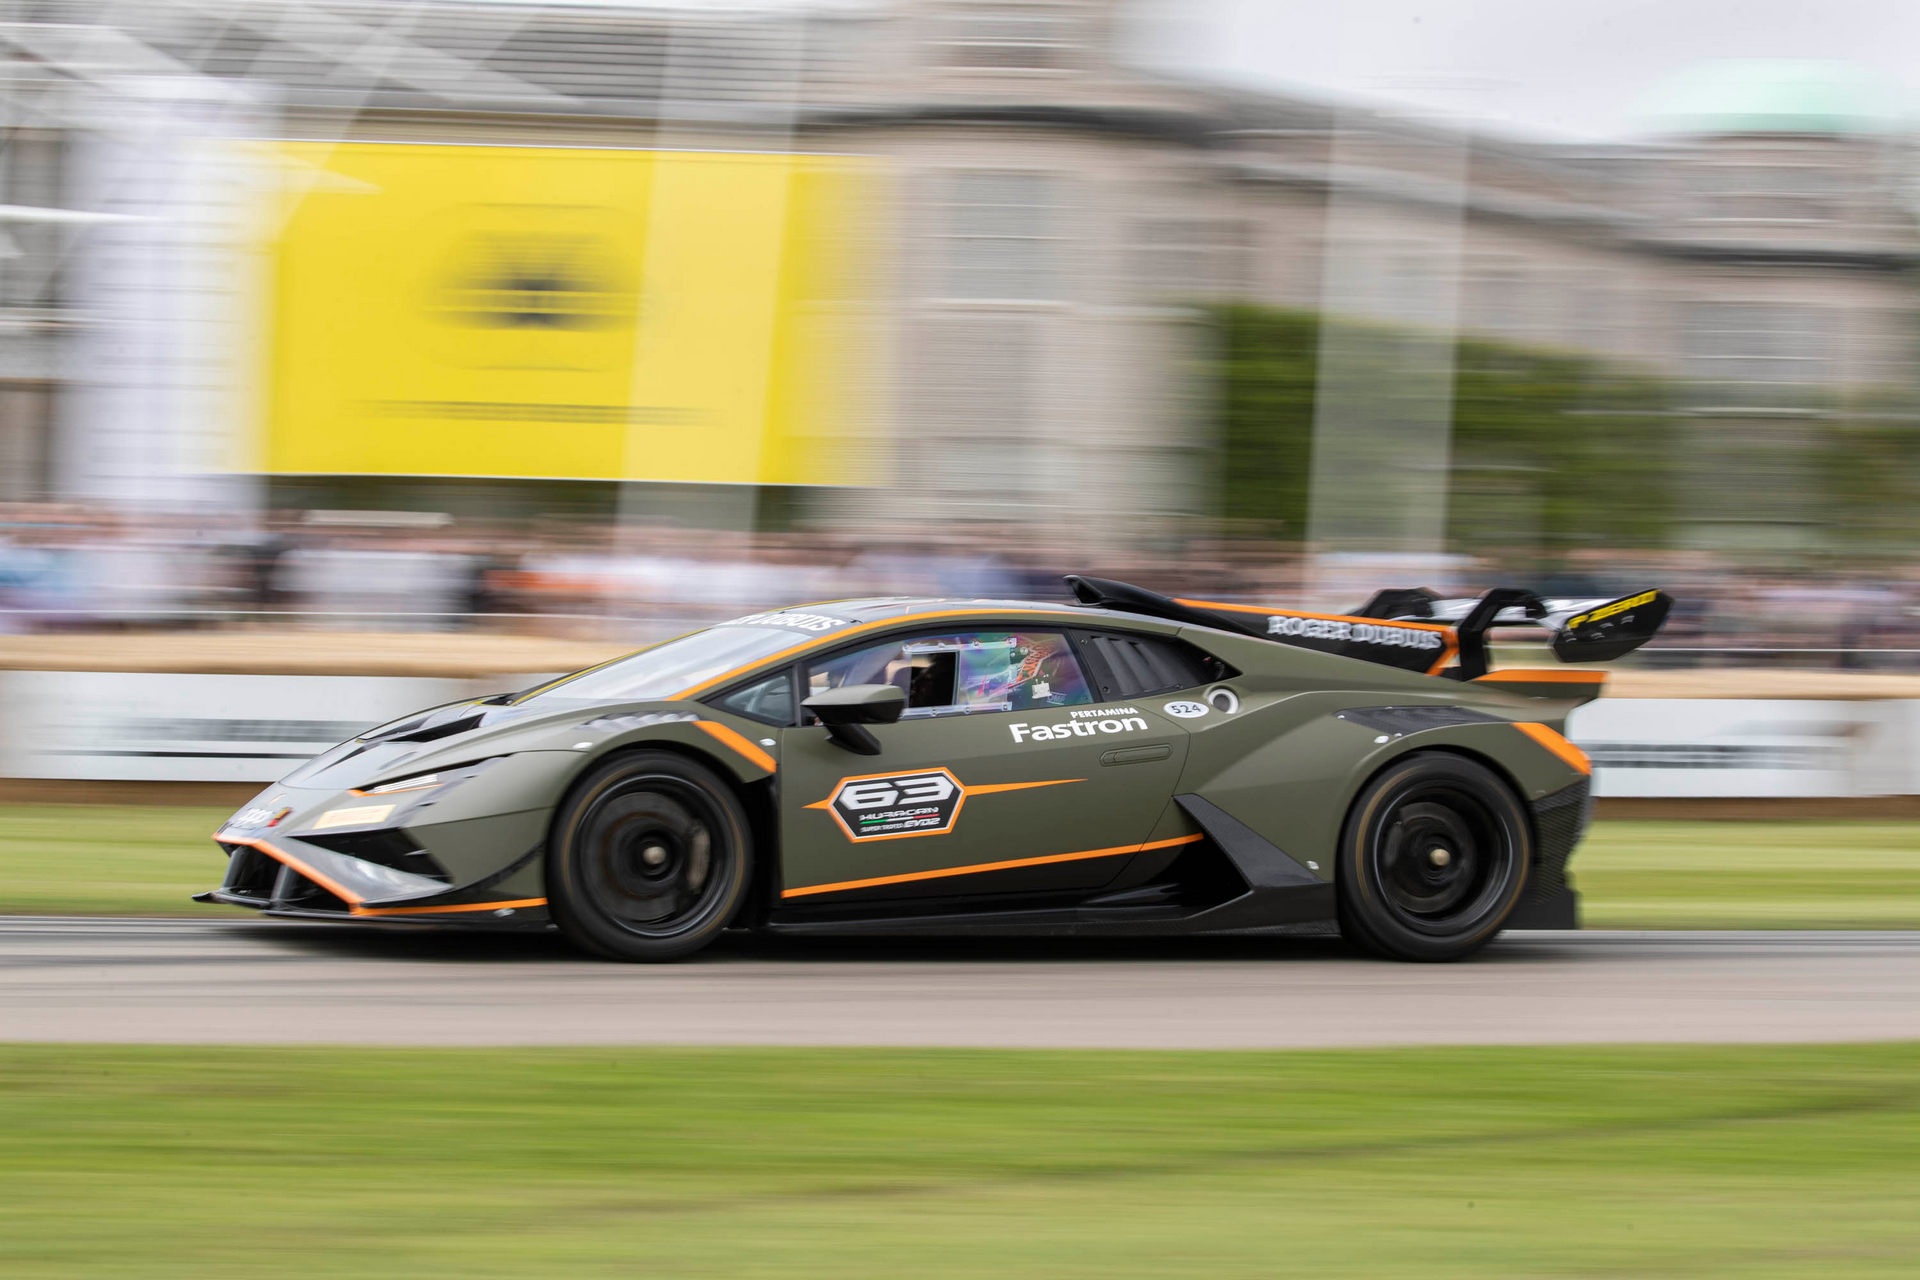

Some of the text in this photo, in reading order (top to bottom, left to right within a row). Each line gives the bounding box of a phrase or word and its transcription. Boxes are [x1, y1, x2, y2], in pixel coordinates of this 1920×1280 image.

[1267, 615, 1442, 650] ROGER DUBUIS
[1070, 706, 1138, 718] PERTAMINA
[1171, 703, 1201, 714] 524
[1008, 716, 1148, 743] Fastron
[839, 776, 954, 810] 63
[859, 807, 939, 821] HURACAN
[903, 817, 941, 829] EVO2
